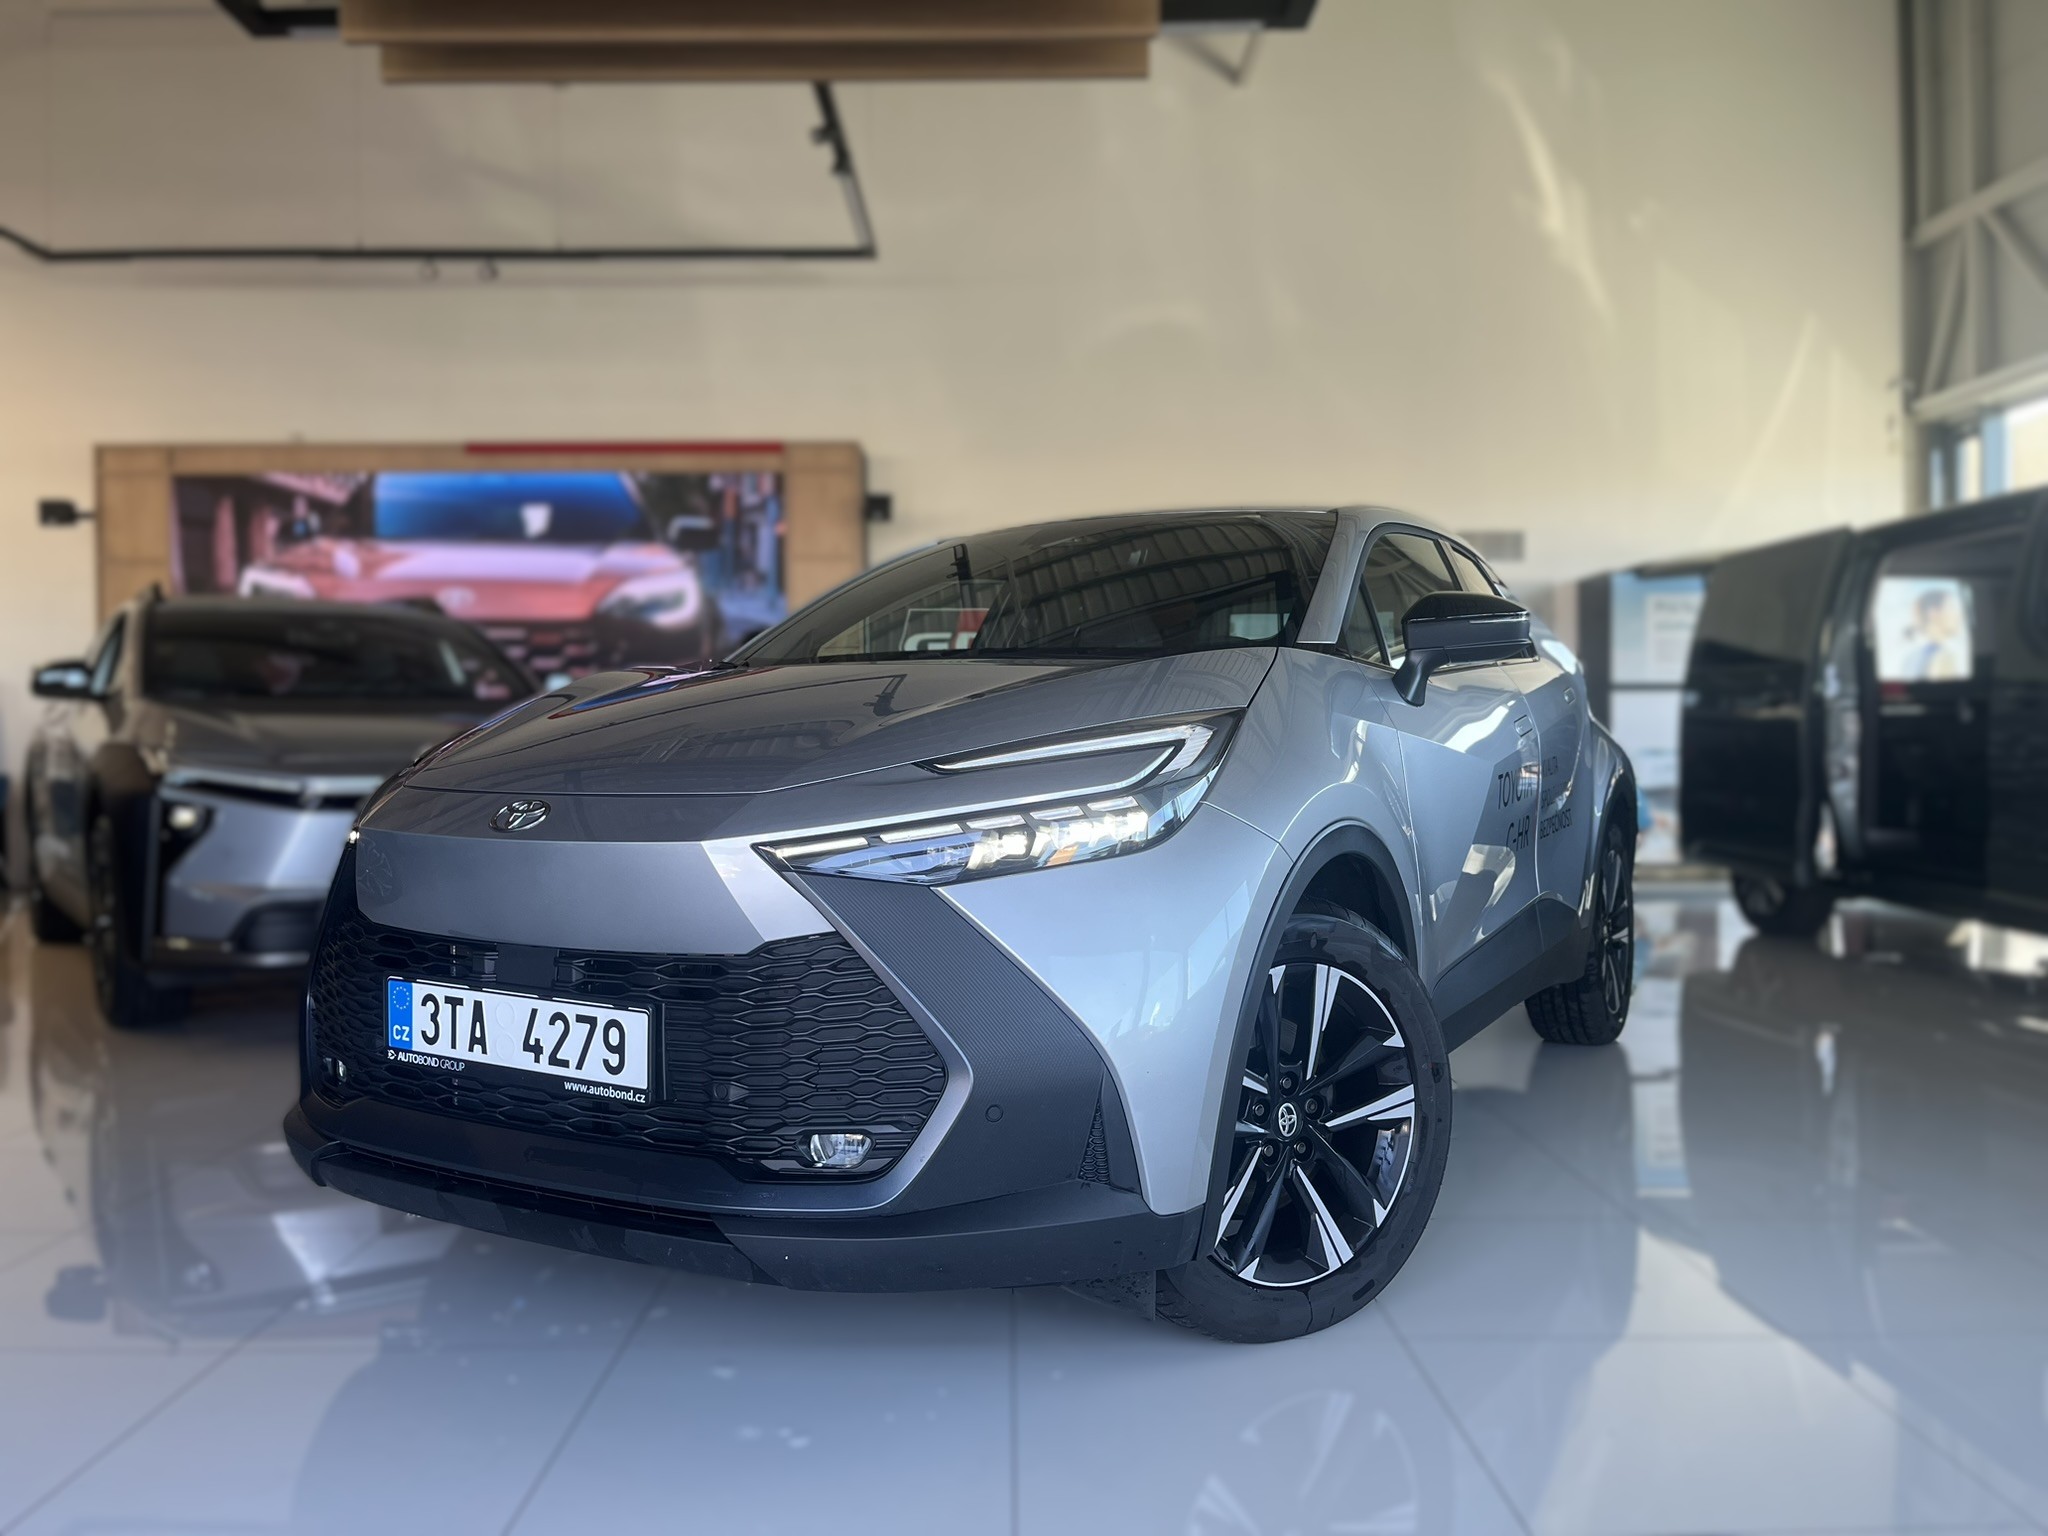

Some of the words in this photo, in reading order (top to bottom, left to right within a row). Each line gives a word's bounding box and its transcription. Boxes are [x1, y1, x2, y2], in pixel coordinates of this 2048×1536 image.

[1505, 815, 1531, 851] C-HR
[392, 1024, 410, 1042] CZ
[420, 993, 488, 1056] 3TA
[522, 1007, 626, 1076] 4279
[397, 1051, 439, 1068] AUTOBOND
[440, 1058, 466, 1072] GROUP
[564, 1079, 646, 1104] www.autobond.cz
